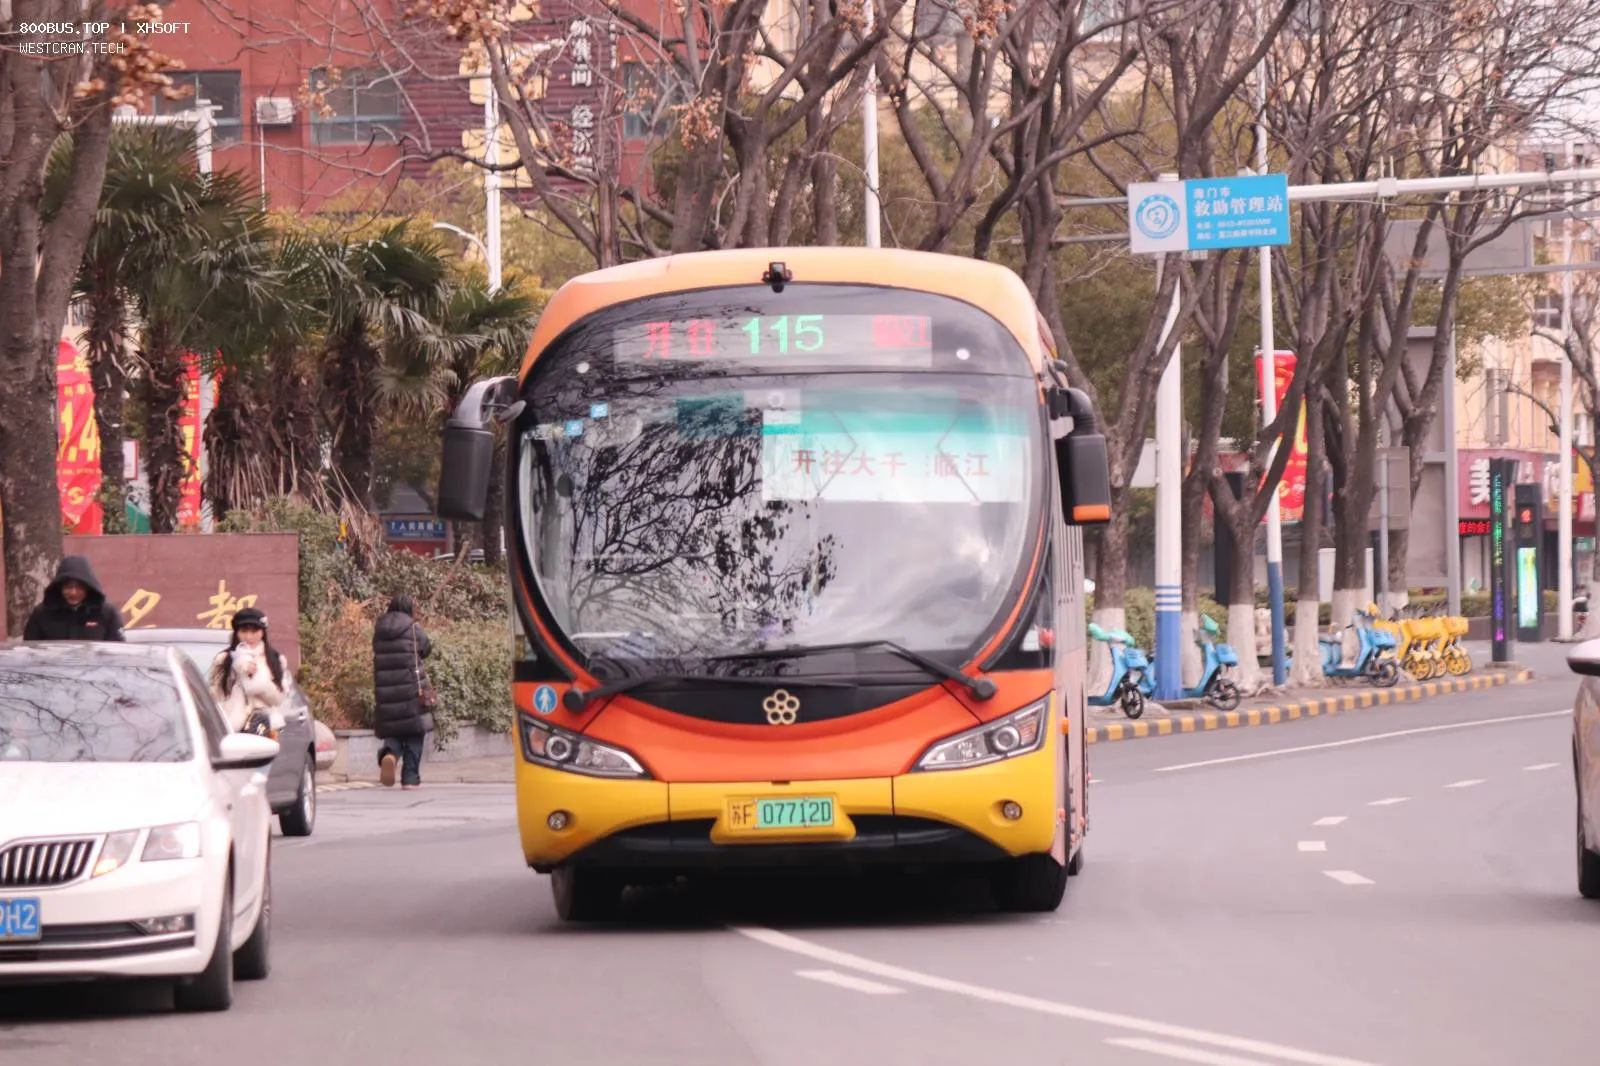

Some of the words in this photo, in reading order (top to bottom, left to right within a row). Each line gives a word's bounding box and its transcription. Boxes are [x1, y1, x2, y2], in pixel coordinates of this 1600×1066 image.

[1195, 194, 1284, 217] 救助管理站
[742, 314, 824, 355] 115
[731, 803, 753, 826] 苏F
[762, 801, 832, 825] 07712D
